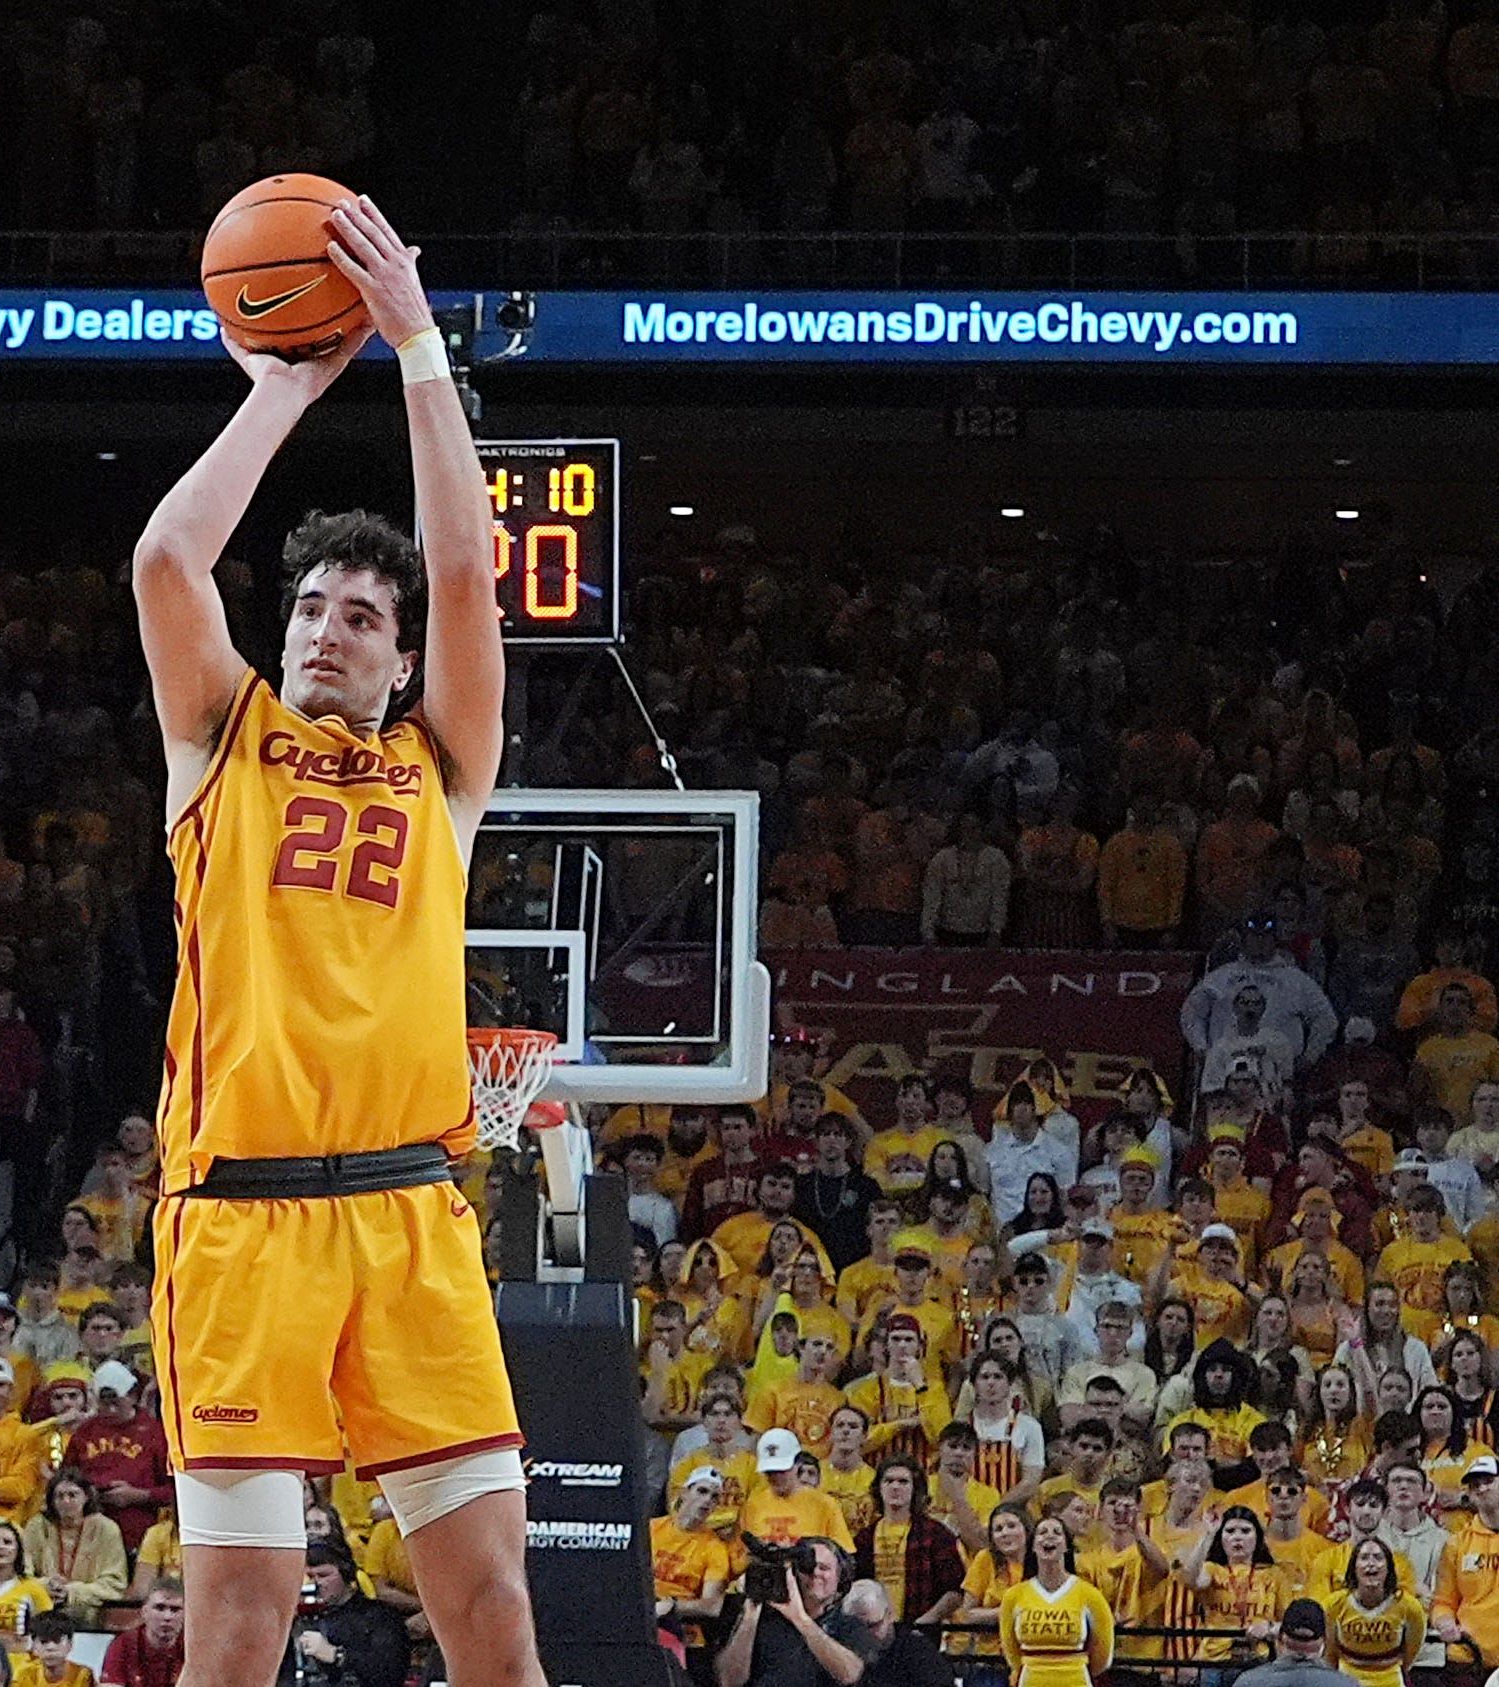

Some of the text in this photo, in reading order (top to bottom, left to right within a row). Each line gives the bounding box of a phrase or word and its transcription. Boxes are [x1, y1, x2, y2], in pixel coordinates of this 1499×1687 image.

[43, 300, 218, 340] Dealers
[623, 302, 1297, 351] MoreIowansDriveChevy.com
[477, 446, 566, 457] AKTRONICS
[271, 795, 410, 910] 22
[192, 1404, 258, 1422] Cyclones
[529, 1462, 623, 1477] XTREAM
[1026, 1609, 1070, 1621] IOWA
[1021, 1622, 1076, 1634] STATE
